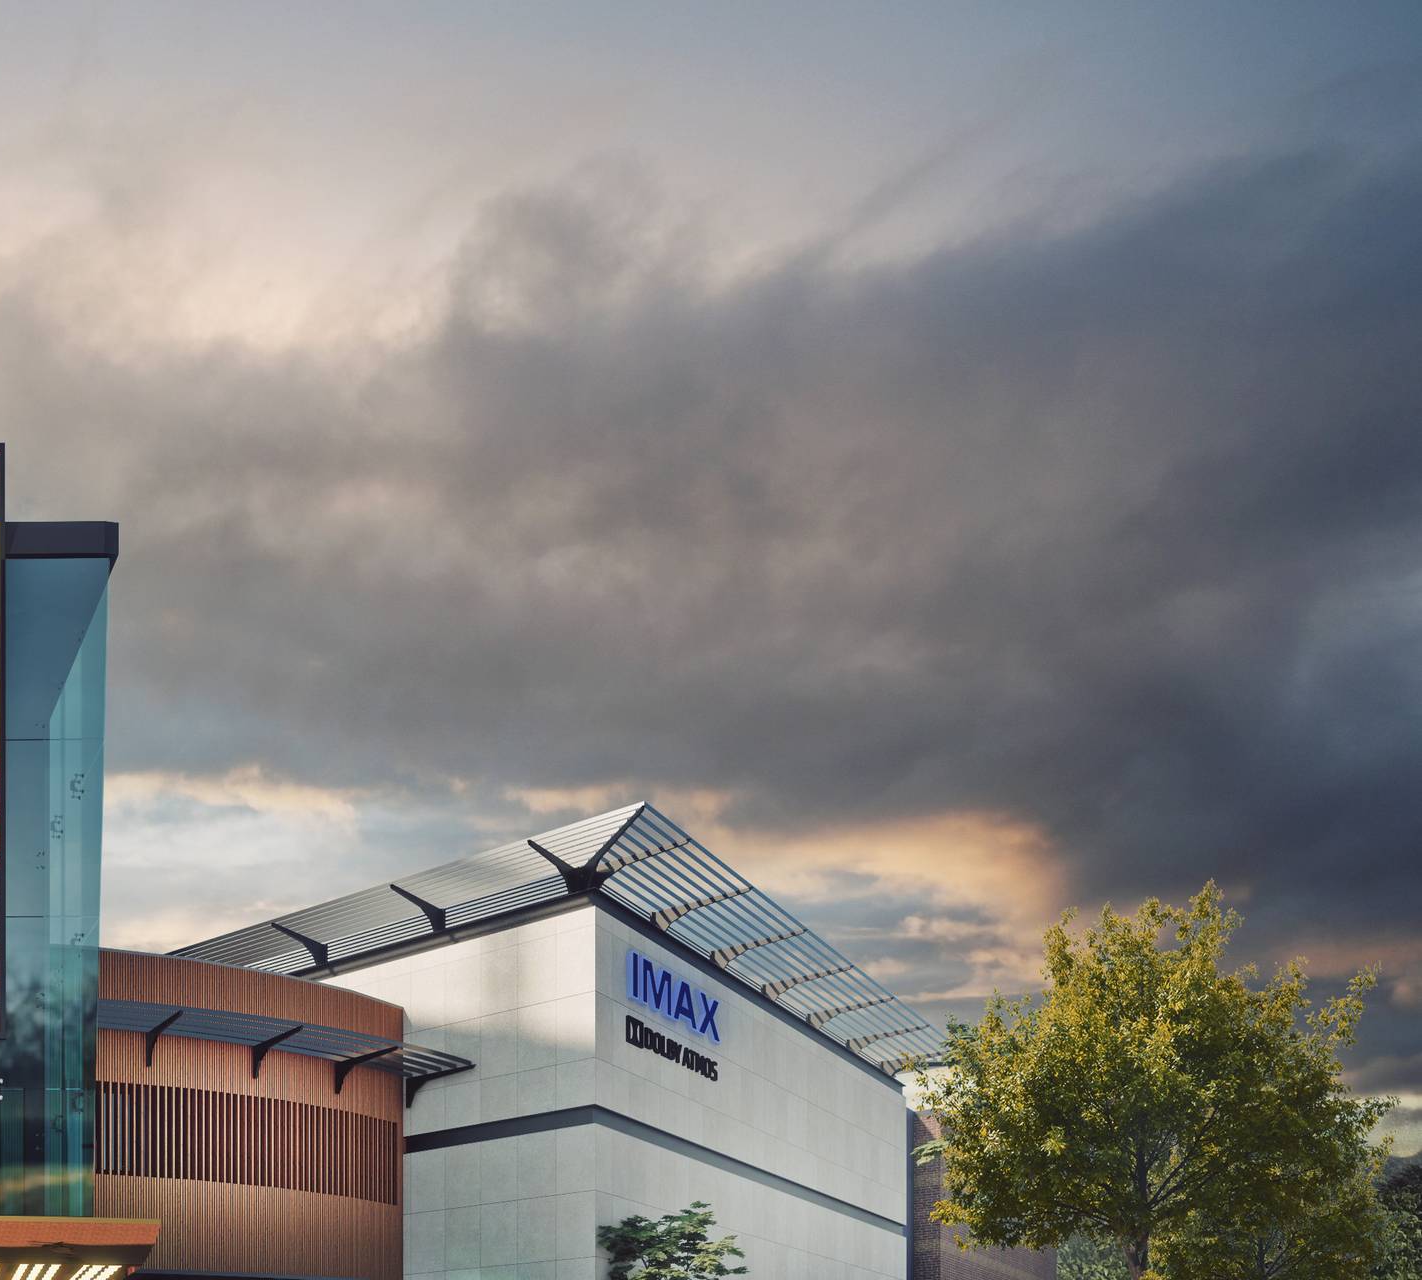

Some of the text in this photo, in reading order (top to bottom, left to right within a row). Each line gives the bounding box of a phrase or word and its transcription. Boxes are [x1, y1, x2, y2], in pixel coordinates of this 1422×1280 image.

[632, 952, 720, 1042] IMAX
[644, 1026, 718, 1082] DOLBY ATMOS
